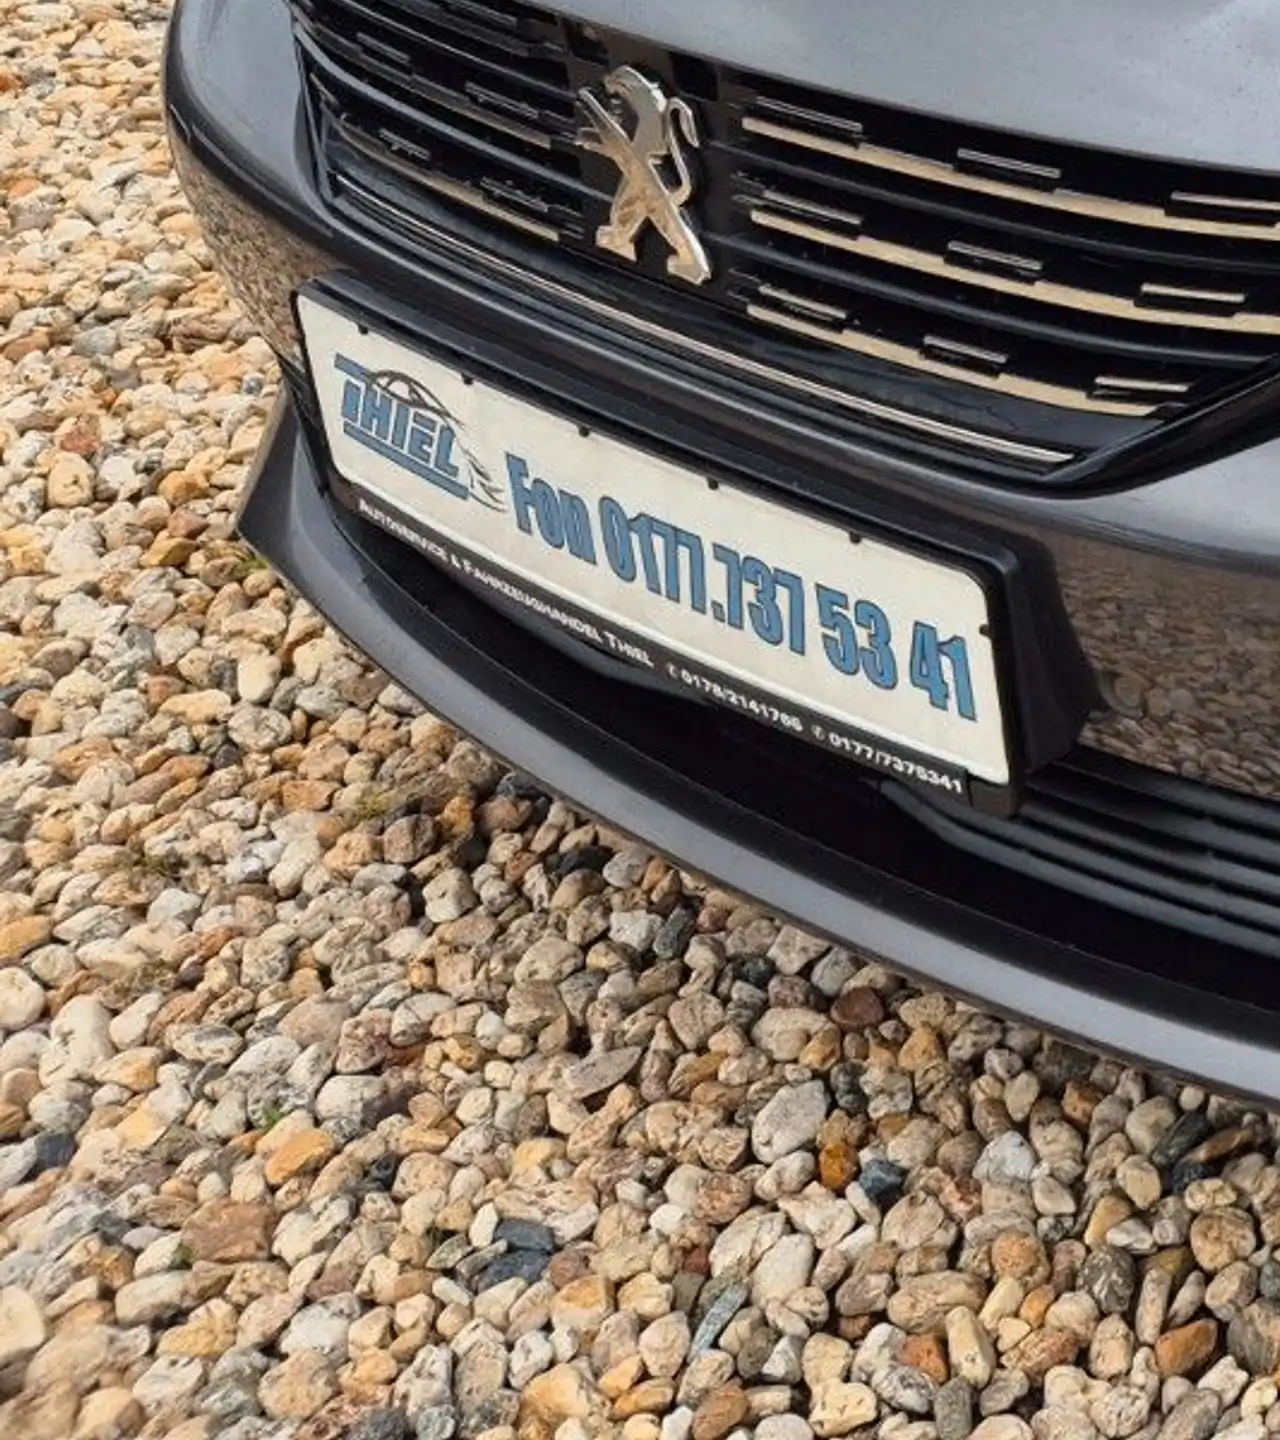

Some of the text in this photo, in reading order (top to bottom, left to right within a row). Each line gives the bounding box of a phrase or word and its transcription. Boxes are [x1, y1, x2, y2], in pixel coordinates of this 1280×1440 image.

[333, 351, 460, 479] THIEL
[505, 451, 977, 722] Fon 0177.737 53 41
